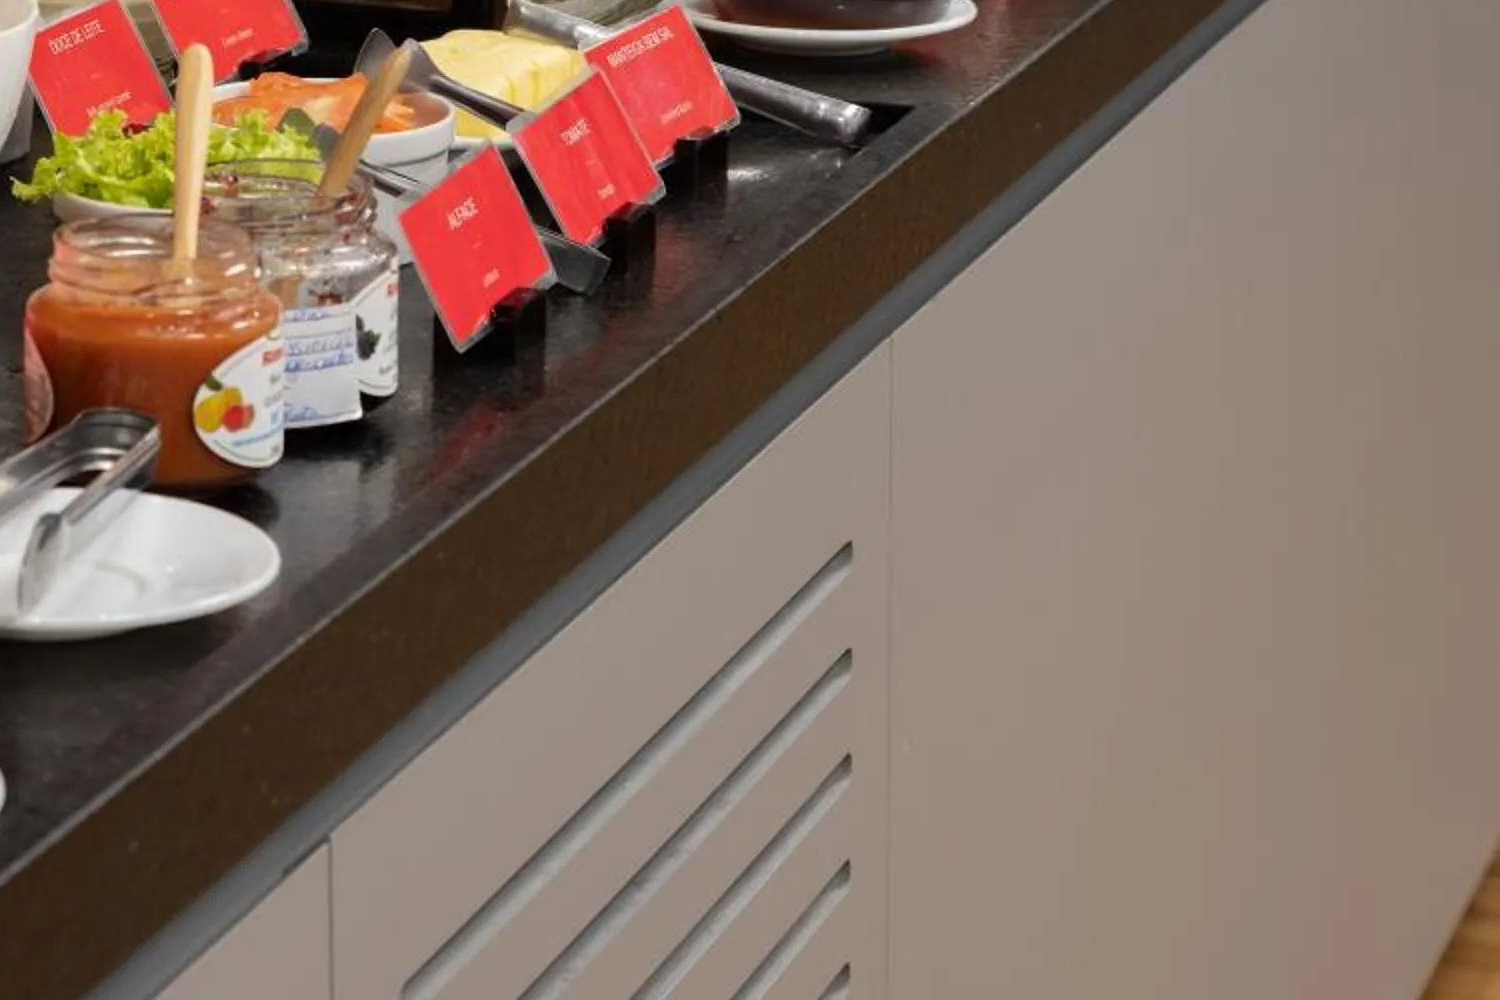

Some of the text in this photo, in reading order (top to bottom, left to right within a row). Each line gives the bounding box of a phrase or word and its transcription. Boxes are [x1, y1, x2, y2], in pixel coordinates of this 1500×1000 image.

[49, 18, 104, 55] DOCE DE LEITE
[561, 118, 592, 146] TOMATE
[448, 196, 480, 231] ALFACE
